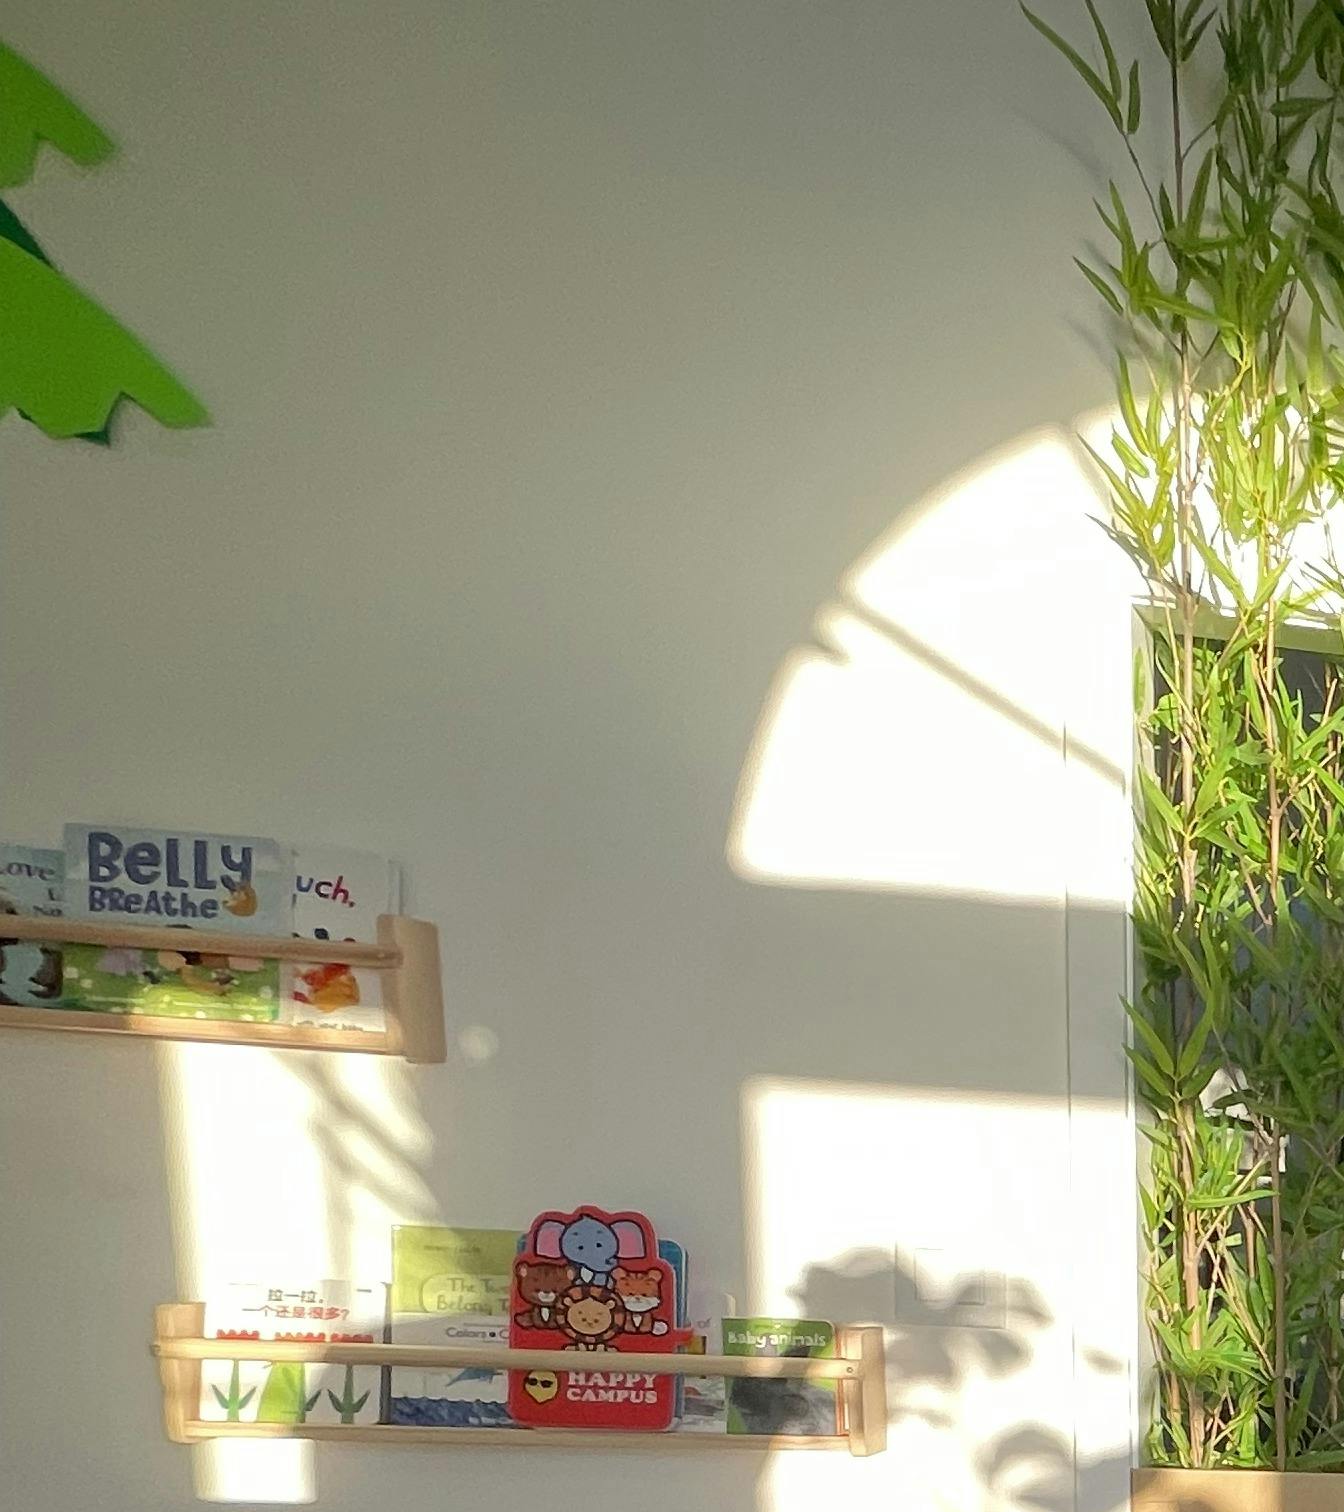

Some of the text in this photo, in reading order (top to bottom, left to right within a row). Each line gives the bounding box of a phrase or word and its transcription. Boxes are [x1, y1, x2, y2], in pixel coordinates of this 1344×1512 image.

[0, 862, 57, 881] ove
[728, 1330, 826, 1348] Baby animals
[568, 1371, 657, 1389] HAPPY
[566, 1388, 658, 1404] CAMPUS
